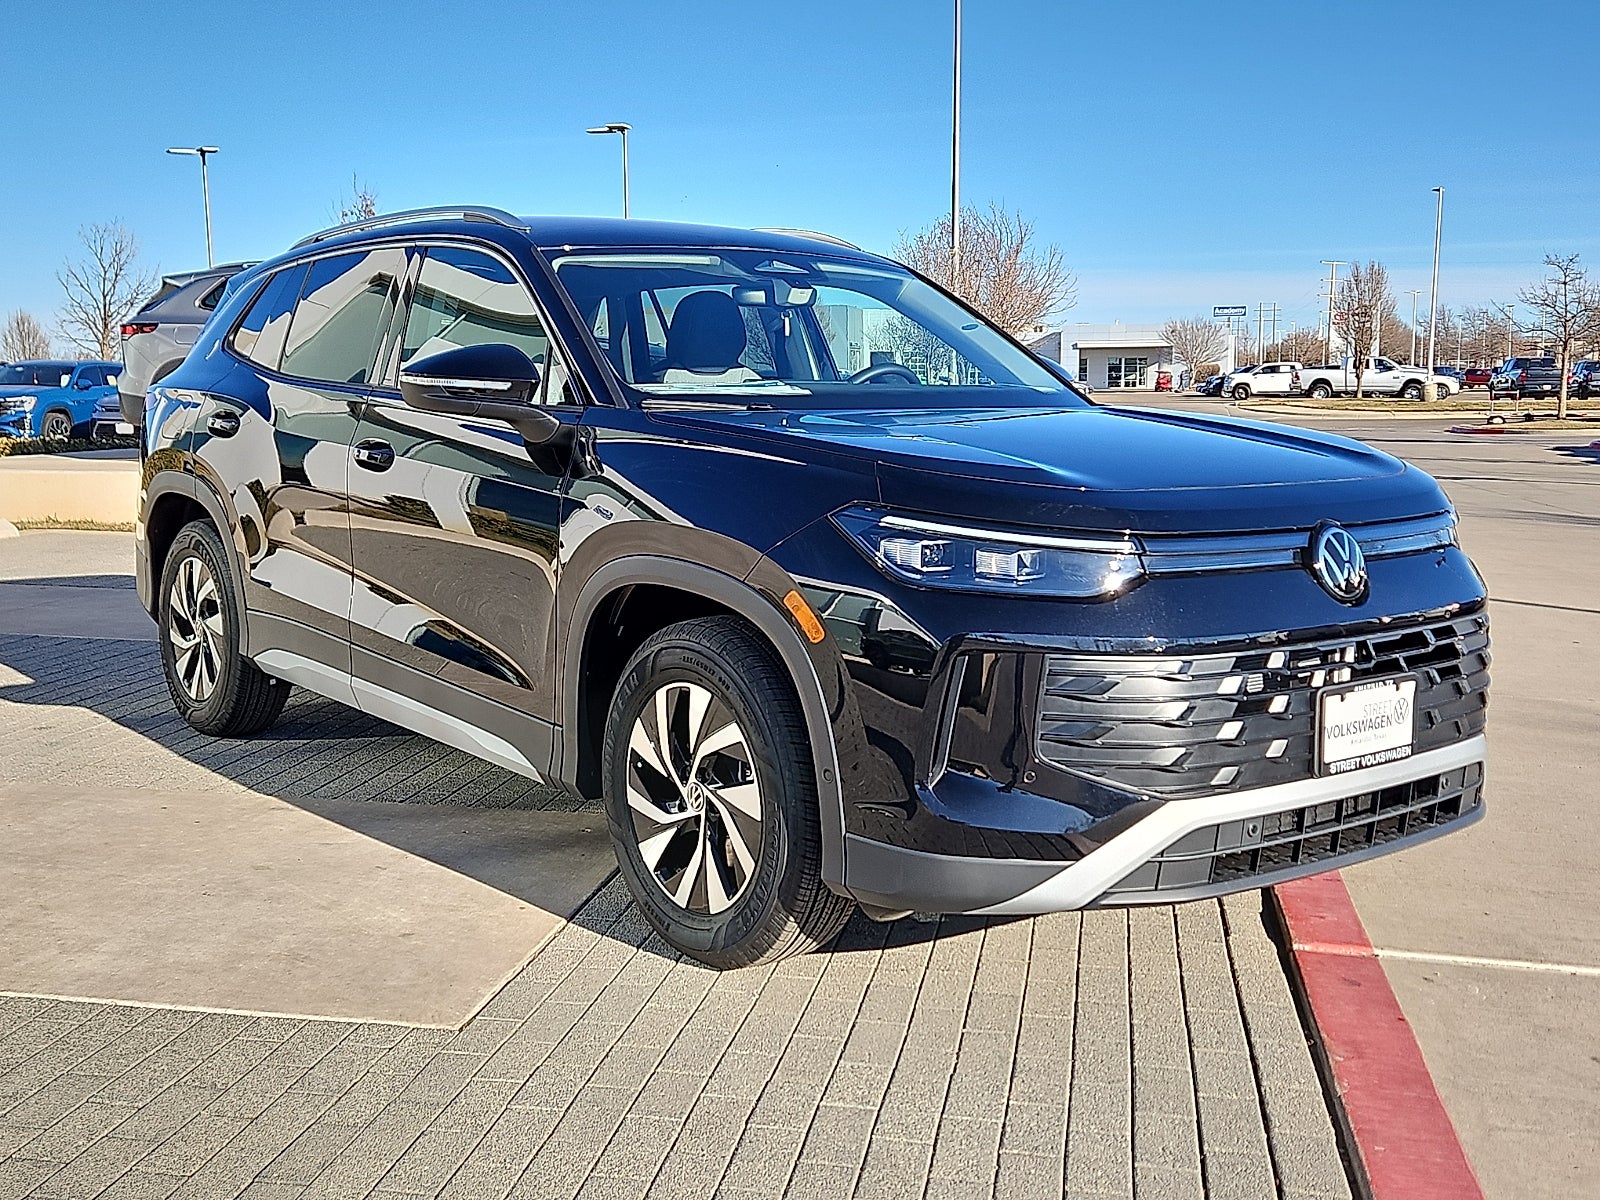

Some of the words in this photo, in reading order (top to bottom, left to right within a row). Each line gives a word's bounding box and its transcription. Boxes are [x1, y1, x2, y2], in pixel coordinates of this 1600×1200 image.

[1214, 307, 1246, 316] Academy
[1363, 700, 1393, 719] STREET
[1325, 713, 1394, 740] VOLKSWAGEN
[1329, 758, 1361, 774] STREET
[1361, 745, 1413, 766] VOLKSWAGEN
